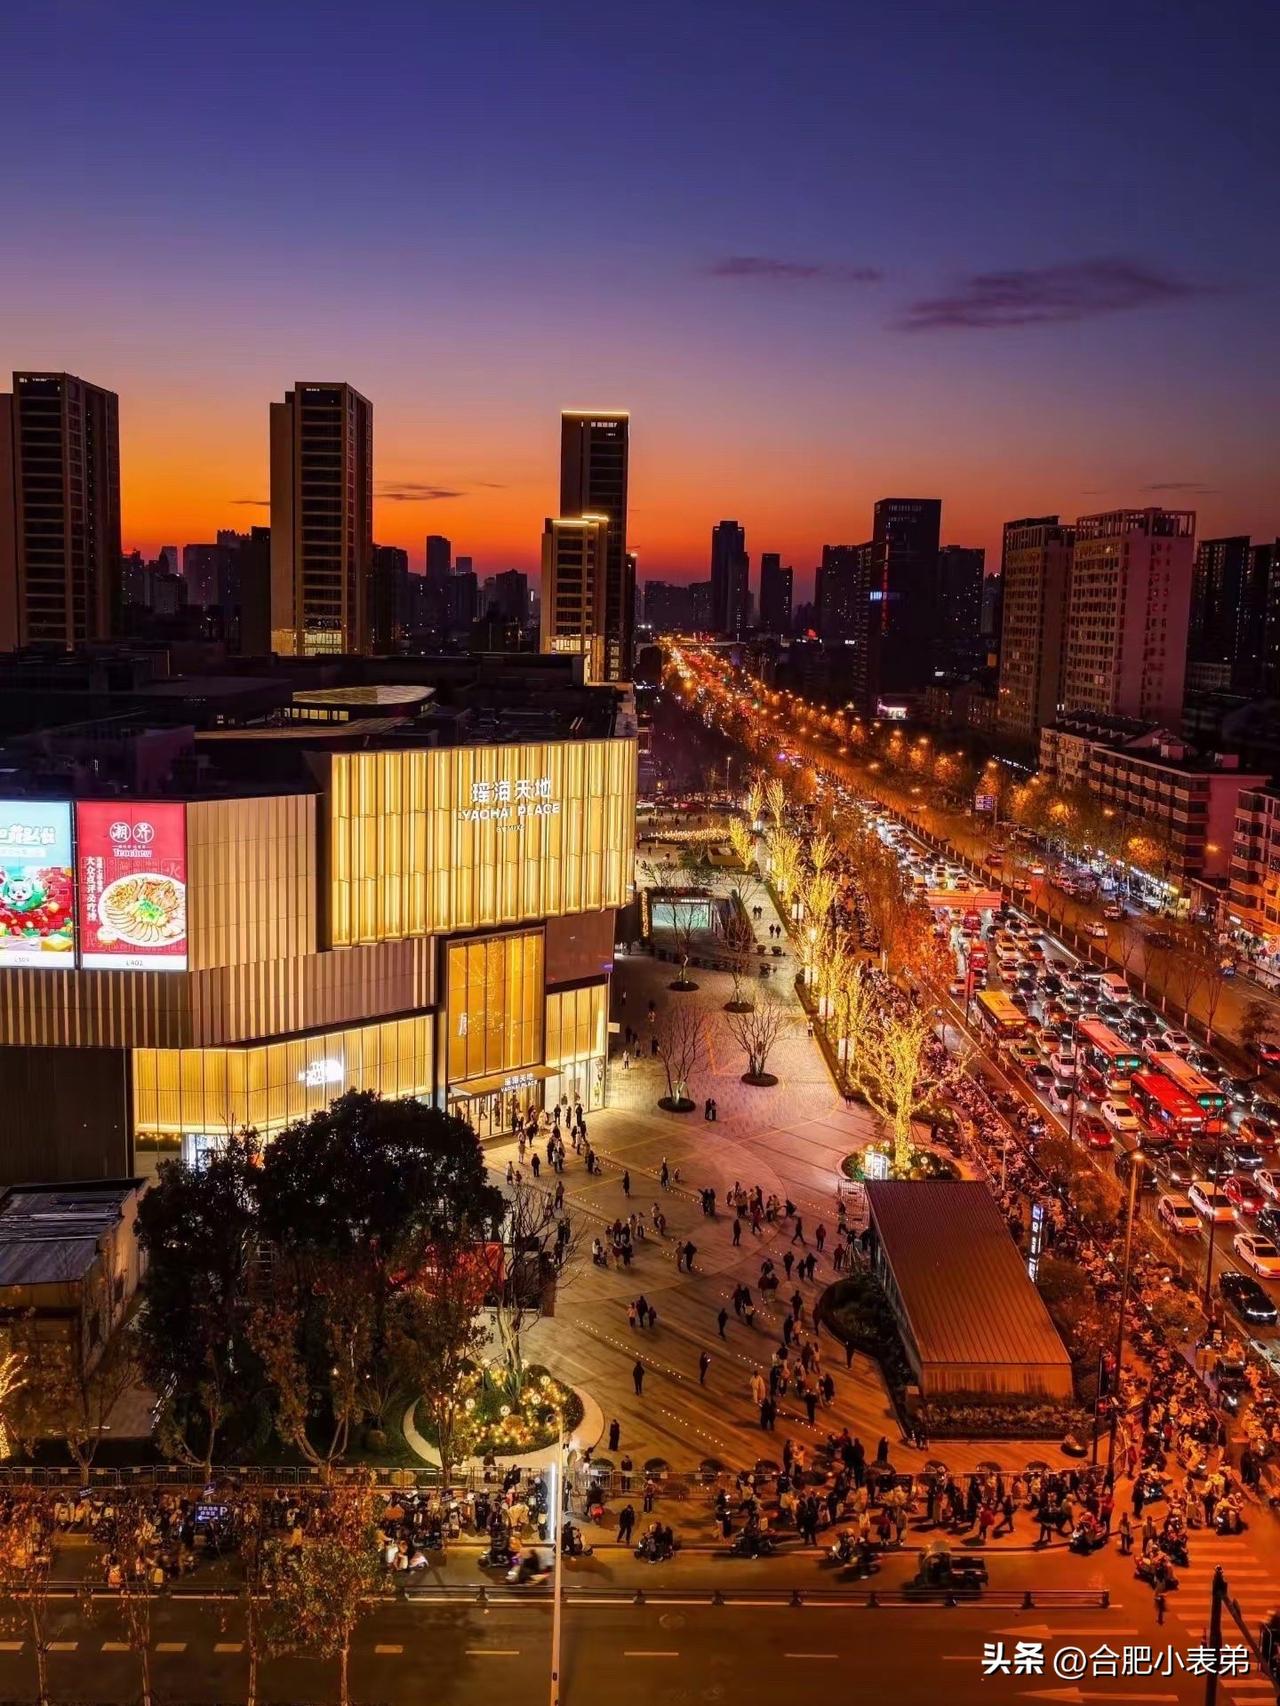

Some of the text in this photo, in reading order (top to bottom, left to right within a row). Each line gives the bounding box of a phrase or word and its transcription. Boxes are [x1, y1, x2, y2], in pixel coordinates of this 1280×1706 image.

[471, 777, 552, 803] 瑶海天地
[461, 802, 561, 821] YAOHAI PLACE
[219, 1506, 228, 1516] P
